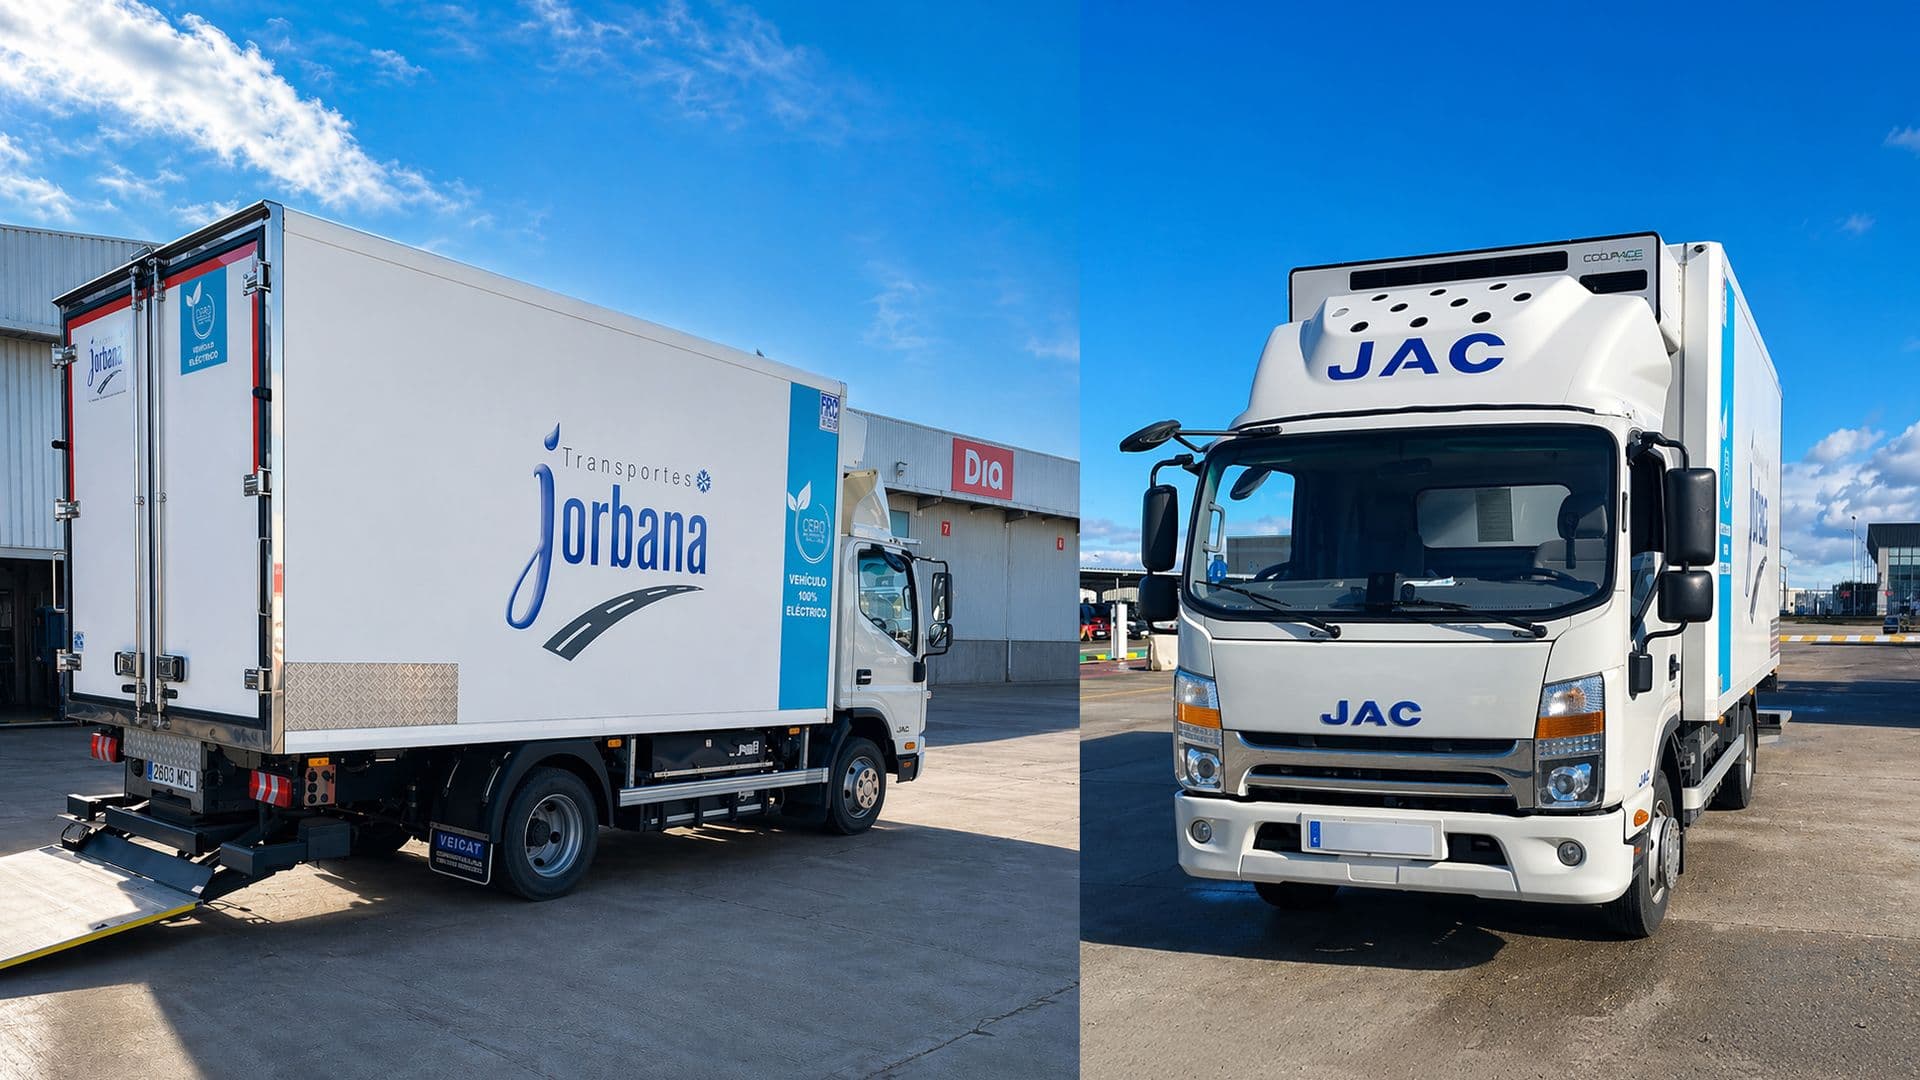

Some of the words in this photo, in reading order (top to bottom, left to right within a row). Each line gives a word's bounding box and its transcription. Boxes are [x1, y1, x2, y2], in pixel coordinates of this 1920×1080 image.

[1327, 332, 1506, 381] JAC
[562, 446, 692, 488] Transportes
[964, 448, 1004, 491] Dia
[802, 518, 825, 533] CERO
[789, 572, 827, 587] VEHÍCULO
[799, 591, 818, 602] 100%
[786, 603, 827, 618] ELÉCTRICO
[1321, 699, 1422, 728] JAC
[896, 725, 910, 733] JAC
[153, 764, 175, 783] 2603
[440, 834, 482, 855] VEICAT
